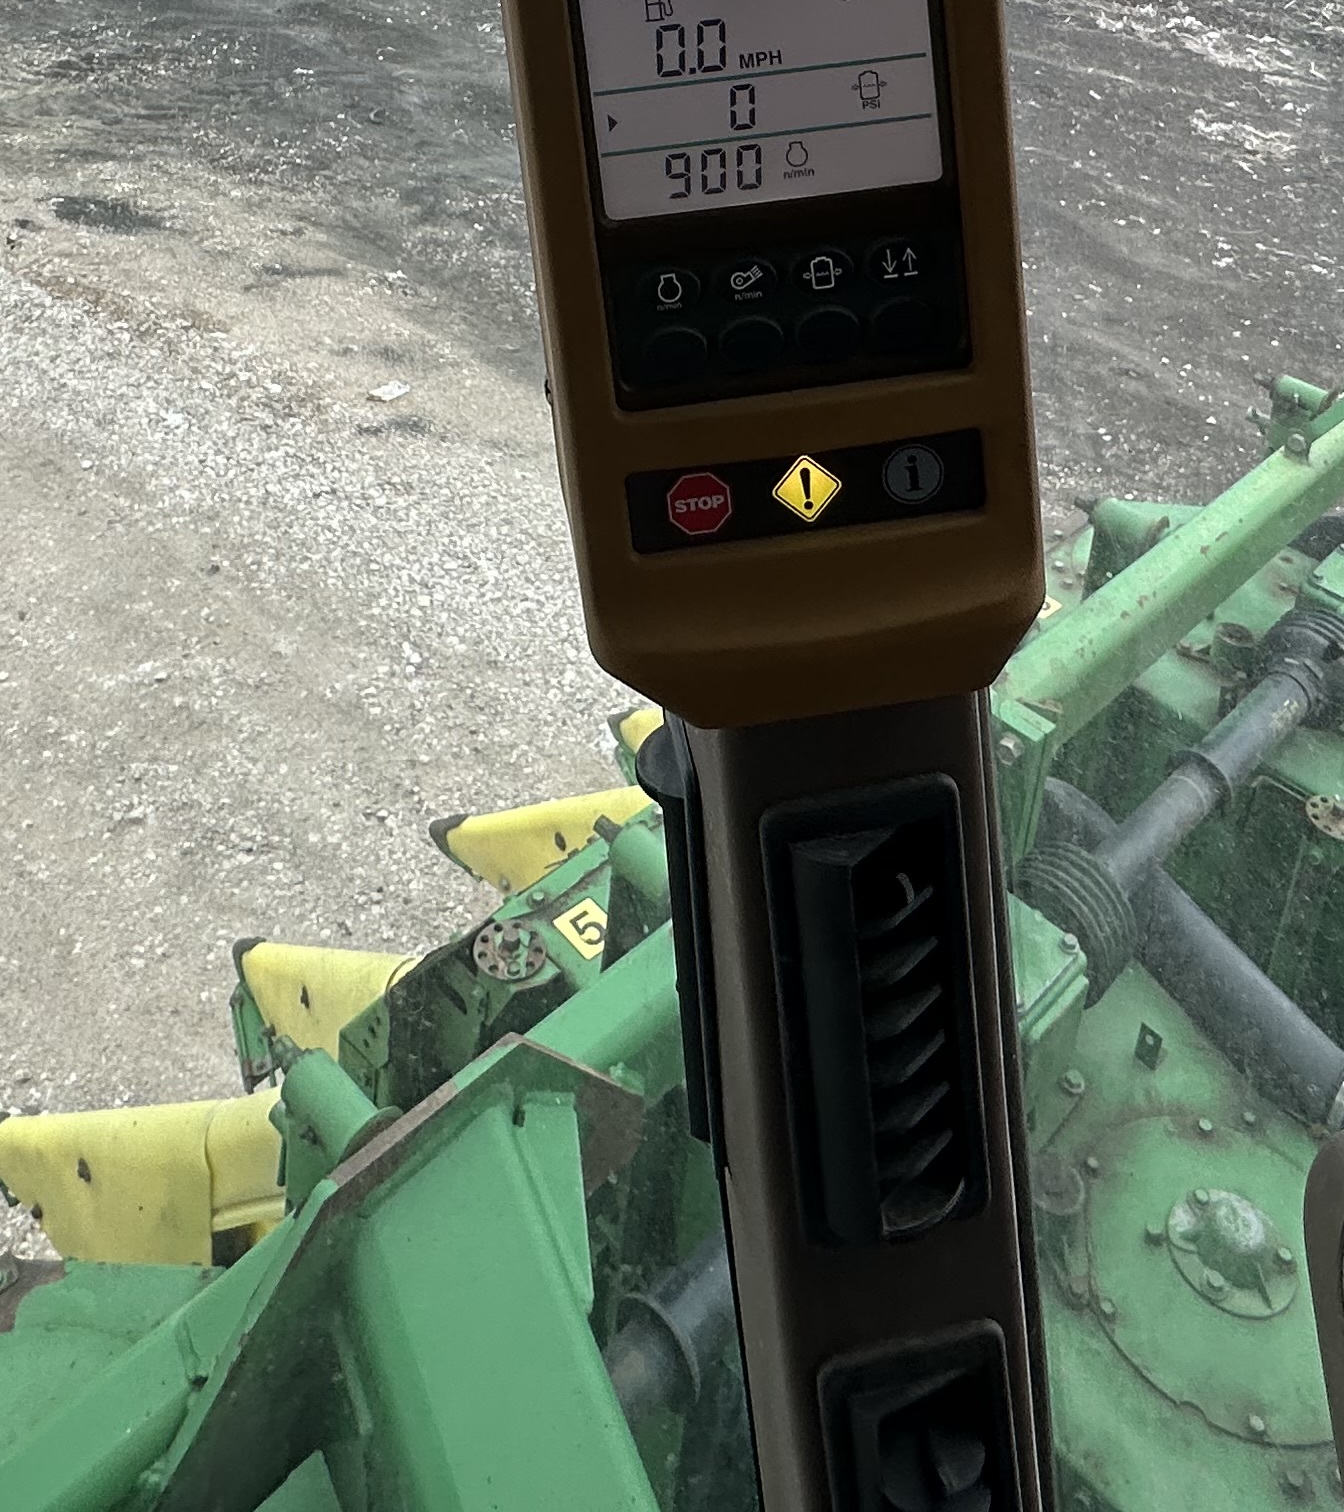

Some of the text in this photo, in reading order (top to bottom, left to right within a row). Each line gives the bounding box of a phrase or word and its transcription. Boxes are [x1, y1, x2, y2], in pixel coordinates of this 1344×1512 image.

[656, 19, 783, 78] 0.0 MPH
[730, 84, 756, 131] 0
[862, 99, 880, 110] PSI
[665, 144, 762, 199] 900
[783, 167, 815, 179] n/min
[734, 291, 762, 301] n/min
[675, 494, 724, 514] STOP
[569, 910, 606, 945] 5
